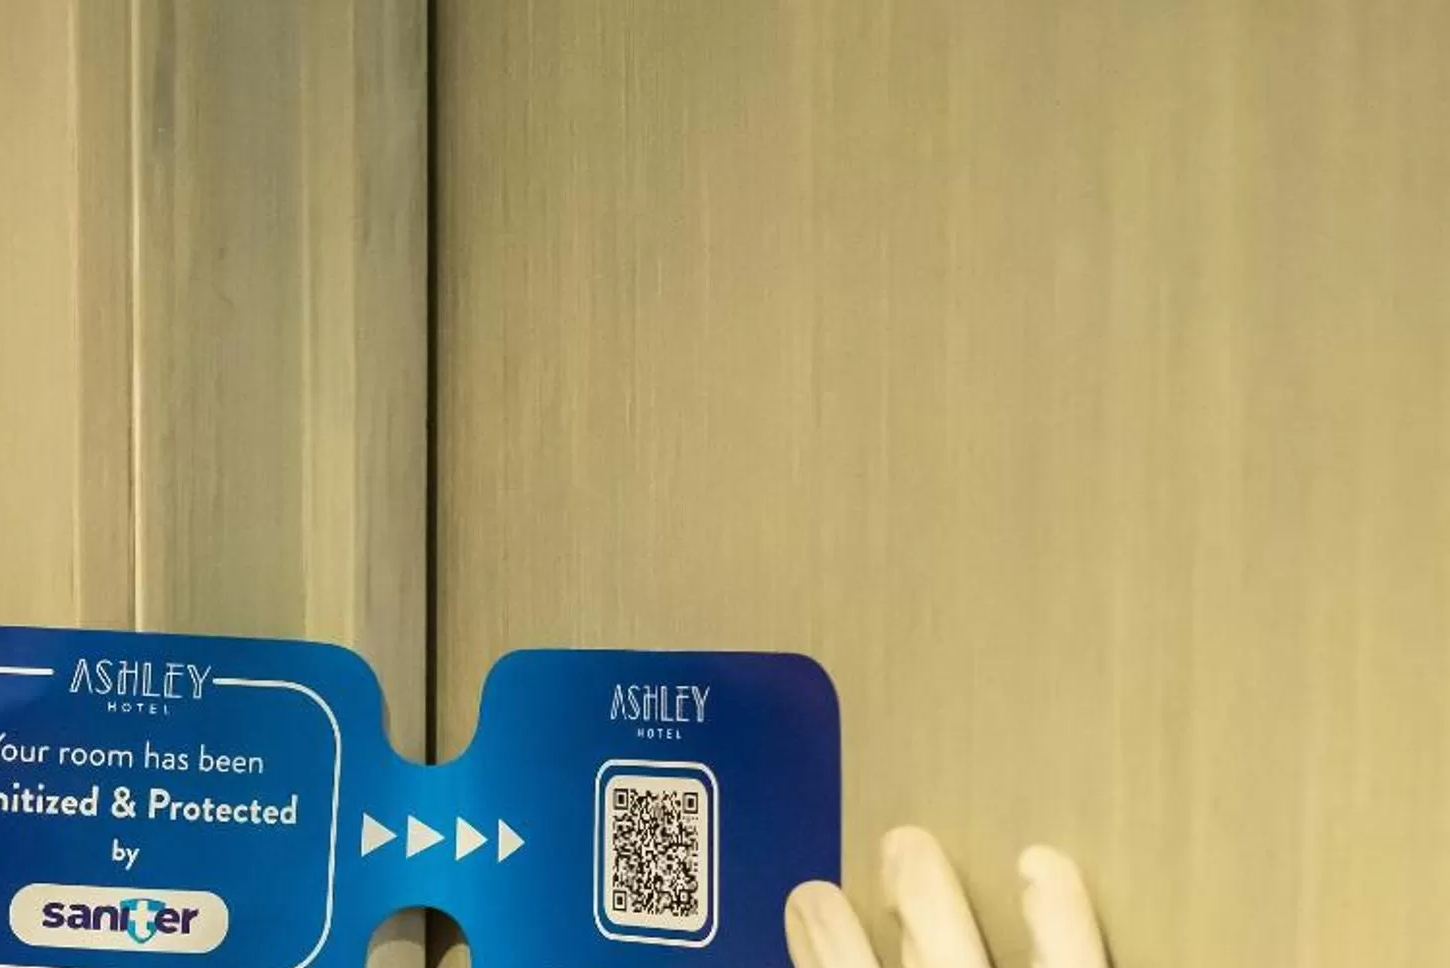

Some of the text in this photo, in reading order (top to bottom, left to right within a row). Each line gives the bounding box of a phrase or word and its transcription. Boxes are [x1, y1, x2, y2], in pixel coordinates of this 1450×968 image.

[69, 658, 212, 700] ASHLEY
[107, 701, 171, 715] HOTEL
[610, 683, 711, 722] ASHLEY
[637, 728, 683, 739] HOTEL
[58, 743, 134, 769] room
[144, 740, 189, 771] has
[199, 743, 264, 774] been
[111, 787, 137, 818] &
[148, 788, 299, 825] Protected
[112, 839, 140, 870] by
[42, 897, 199, 943] saniter
